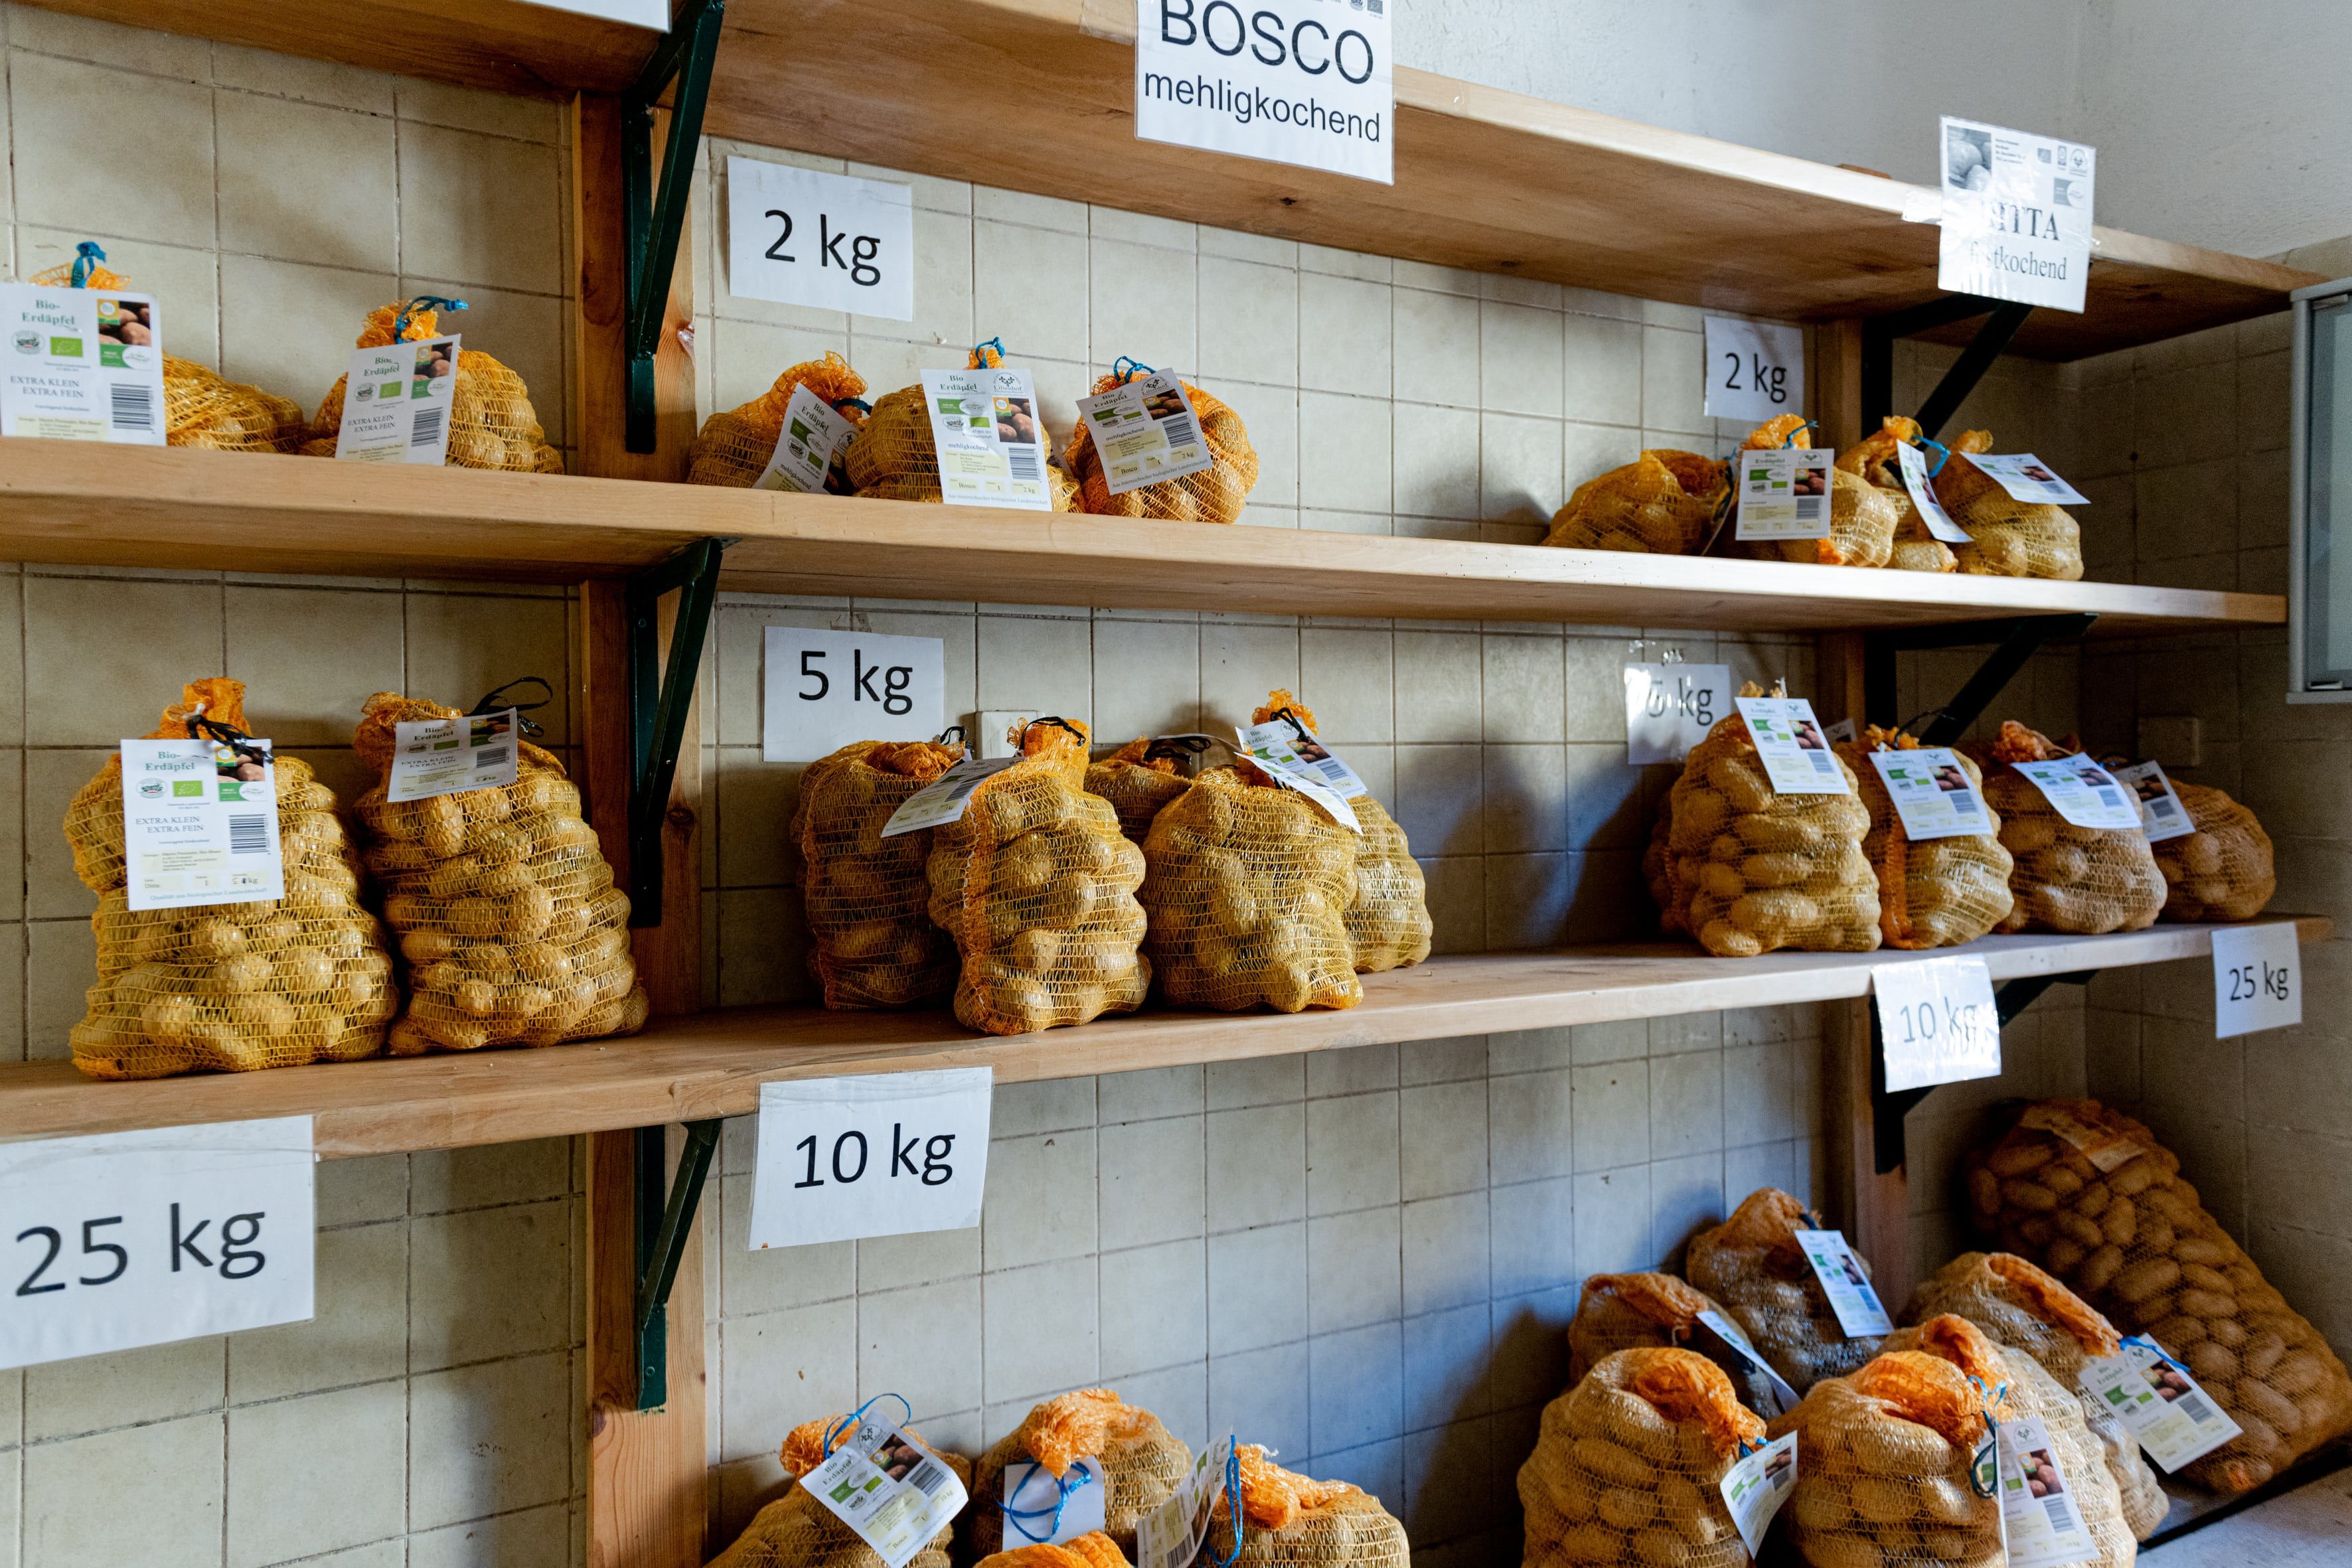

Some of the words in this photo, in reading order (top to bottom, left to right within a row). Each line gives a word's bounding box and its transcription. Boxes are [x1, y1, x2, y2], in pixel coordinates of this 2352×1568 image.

[1161, 0, 1374, 84] BOSCO
[1145, 72, 1380, 143] mehligkochend
[765, 209, 795, 263] 2
[820, 213, 881, 286] kg
[22, 312, 76, 326] Erdäpfel
[364, 364, 400, 377] Erdäpfel
[11, 375, 45, 385] EXTRA
[48, 378, 80, 388] KLEIN
[1725, 353, 1741, 390] 2
[1754, 353, 1786, 404] kg
[23, 386, 58, 396] EXTRA
[60, 389, 84, 398] FEIN
[939, 383, 978, 392] Erdäpfel
[813, 403, 825, 416] Bio
[347, 417, 372, 426] EXTRA
[372, 414, 394, 424] KLEIN
[801, 406, 830, 432] Erdäpfel
[354, 424, 378, 433] EXTRA
[379, 421, 396, 430] FEIN
[1105, 426, 1145, 441] mehligkochend
[948, 442, 989, 451] mehligkochend
[1121, 466, 1138, 475] Bosco
[1178, 459, 1209, 473] Landwirtschaft
[780, 463, 812, 490] mehligkochend
[799, 650, 829, 701] 5
[854, 648, 913, 716] kg
[1679, 677, 1713, 726] kg
[145, 762, 196, 773] Erdäpfel
[2229, 966, 2256, 1001] 25
[2263, 960, 2289, 1000] kg
[1899, 1002, 1936, 1044] 10
[794, 1130, 868, 1189] 10
[891, 1123, 956, 1186] kg
[15, 1215, 129, 1296] 25
[169, 1202, 267, 1280] kg
[824, 1462, 838, 1474] Bio
